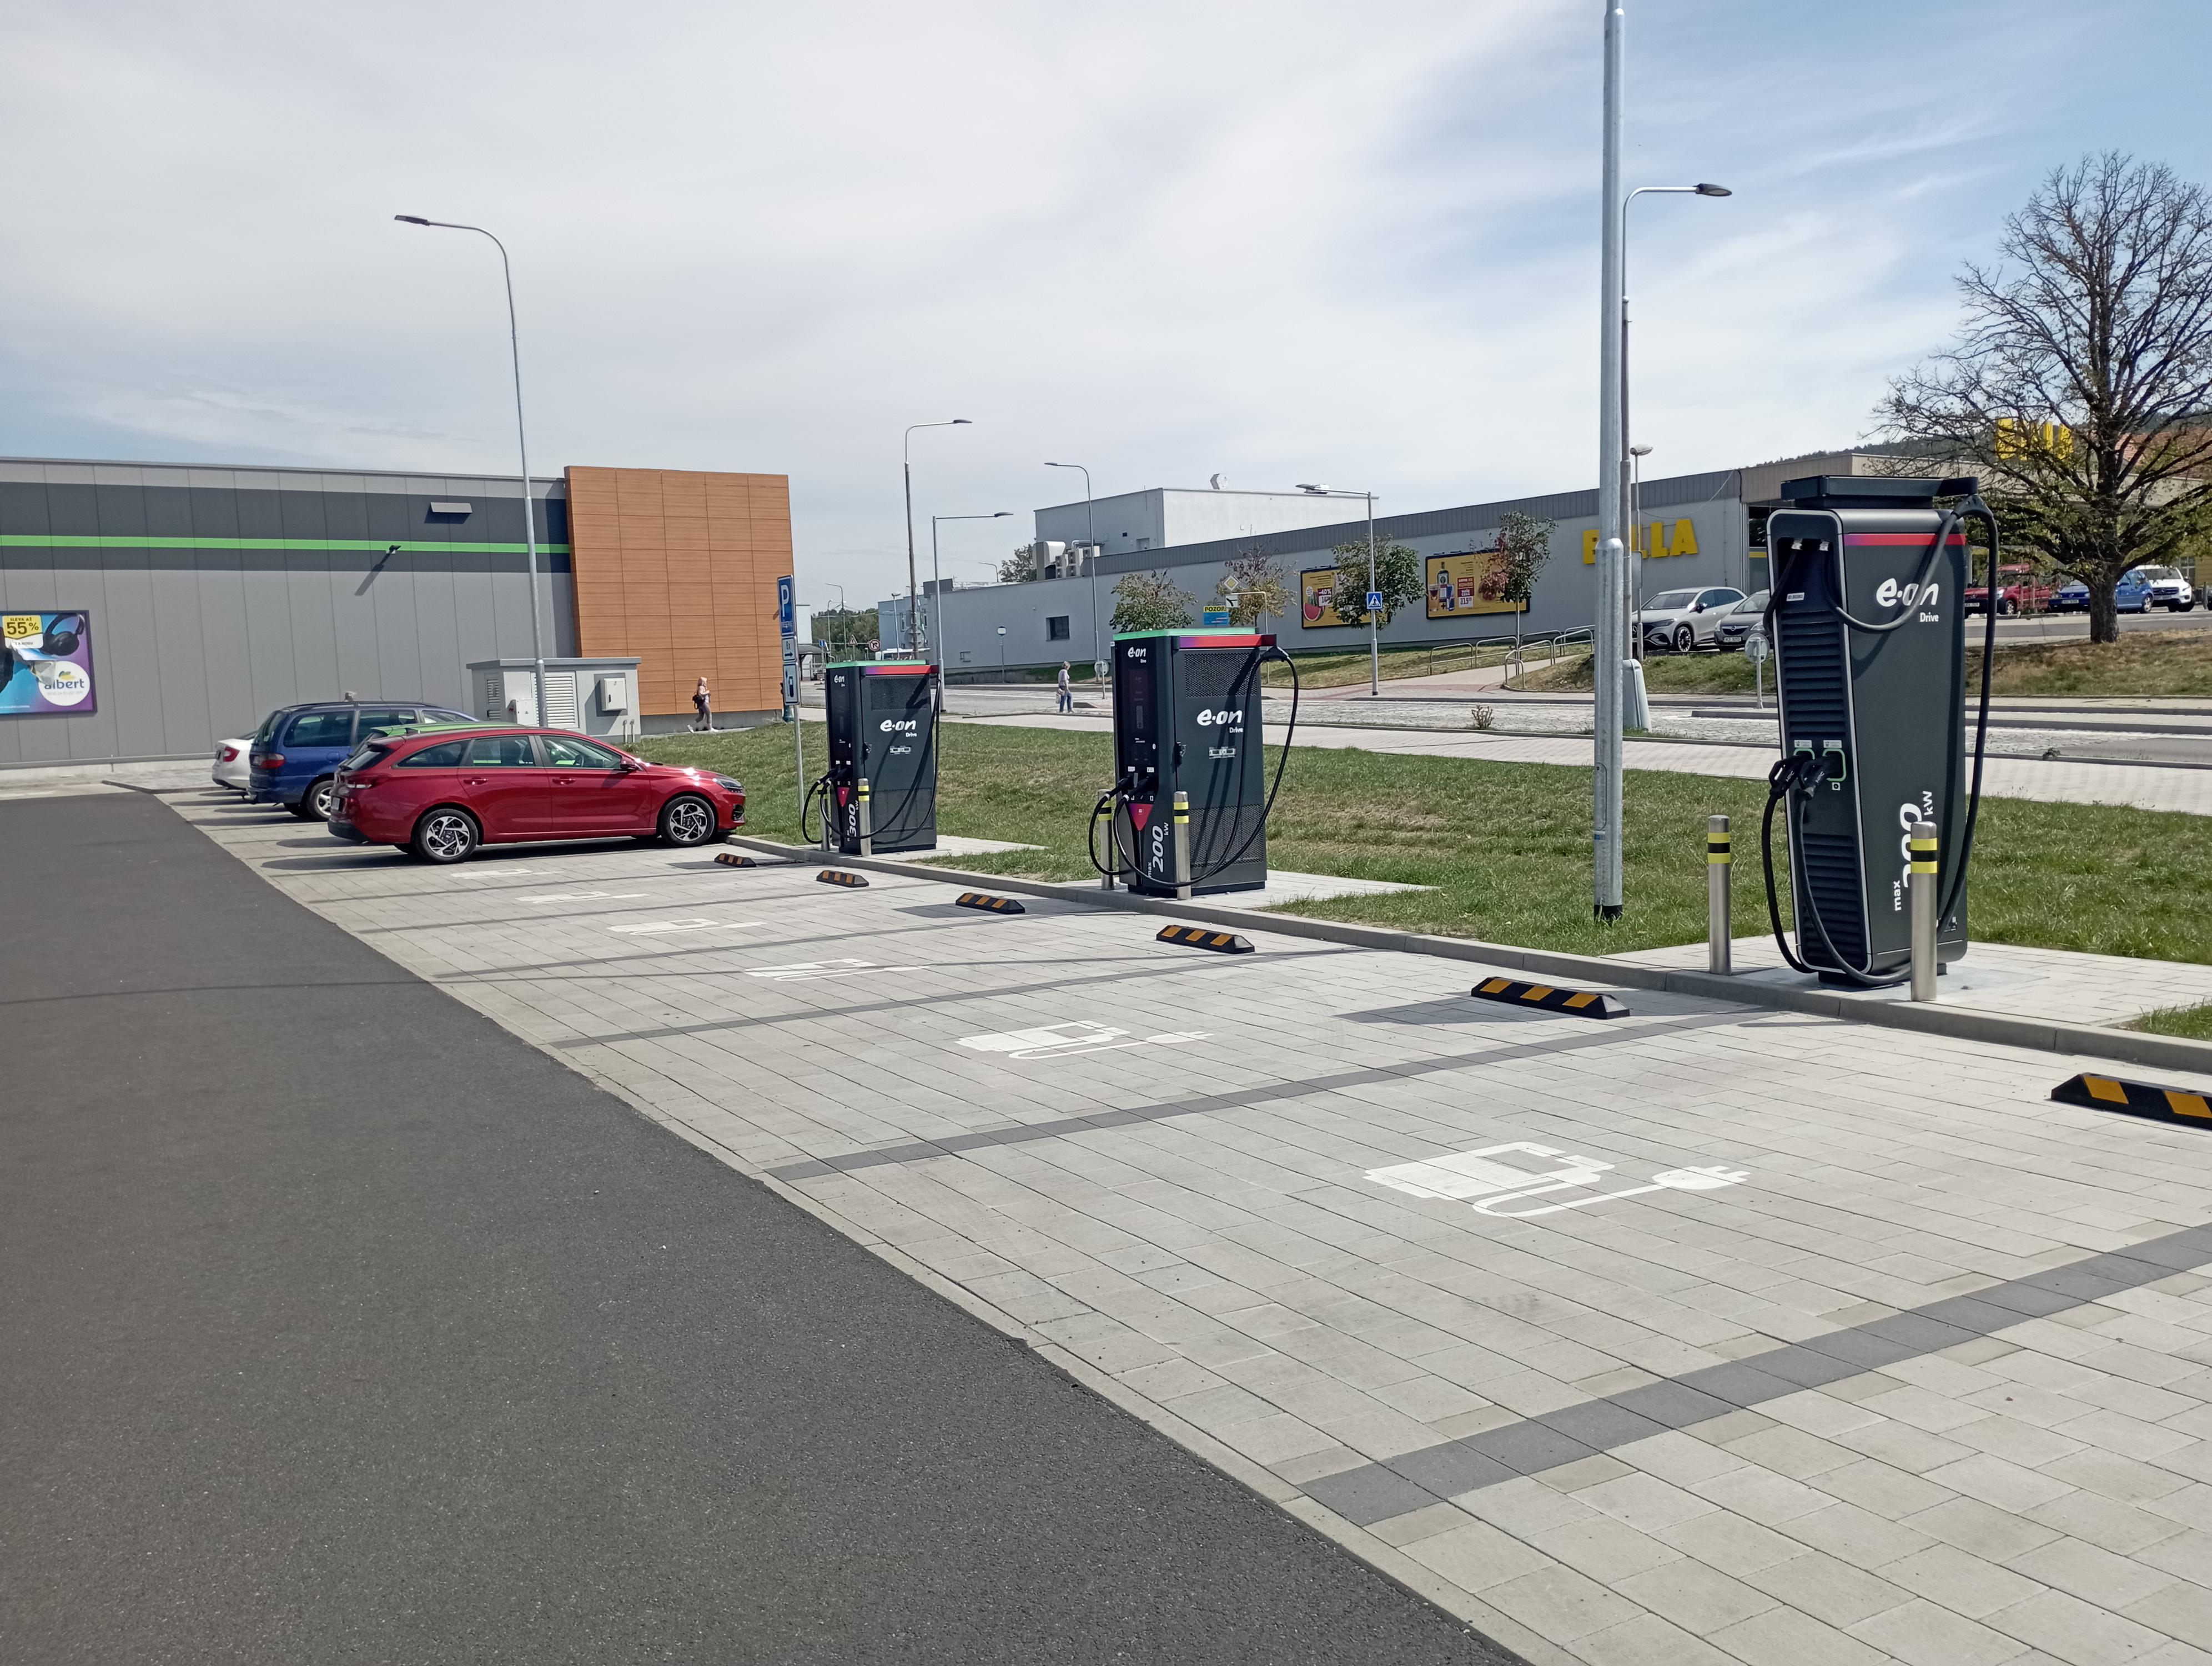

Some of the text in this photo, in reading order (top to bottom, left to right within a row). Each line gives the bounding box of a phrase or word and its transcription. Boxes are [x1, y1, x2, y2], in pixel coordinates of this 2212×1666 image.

[1583, 519, 1698, 564] BLLA
[781, 584, 790, 618] P
[1919, 612, 1939, 623] Drive
[44, 678, 85, 689] albert
[1923, 790, 1933, 815] kW
[848, 804, 857, 837] 300
[1164, 822, 1169, 836] kW
[1153, 825, 1164, 873] 200
[1893, 880, 1902, 911] max
